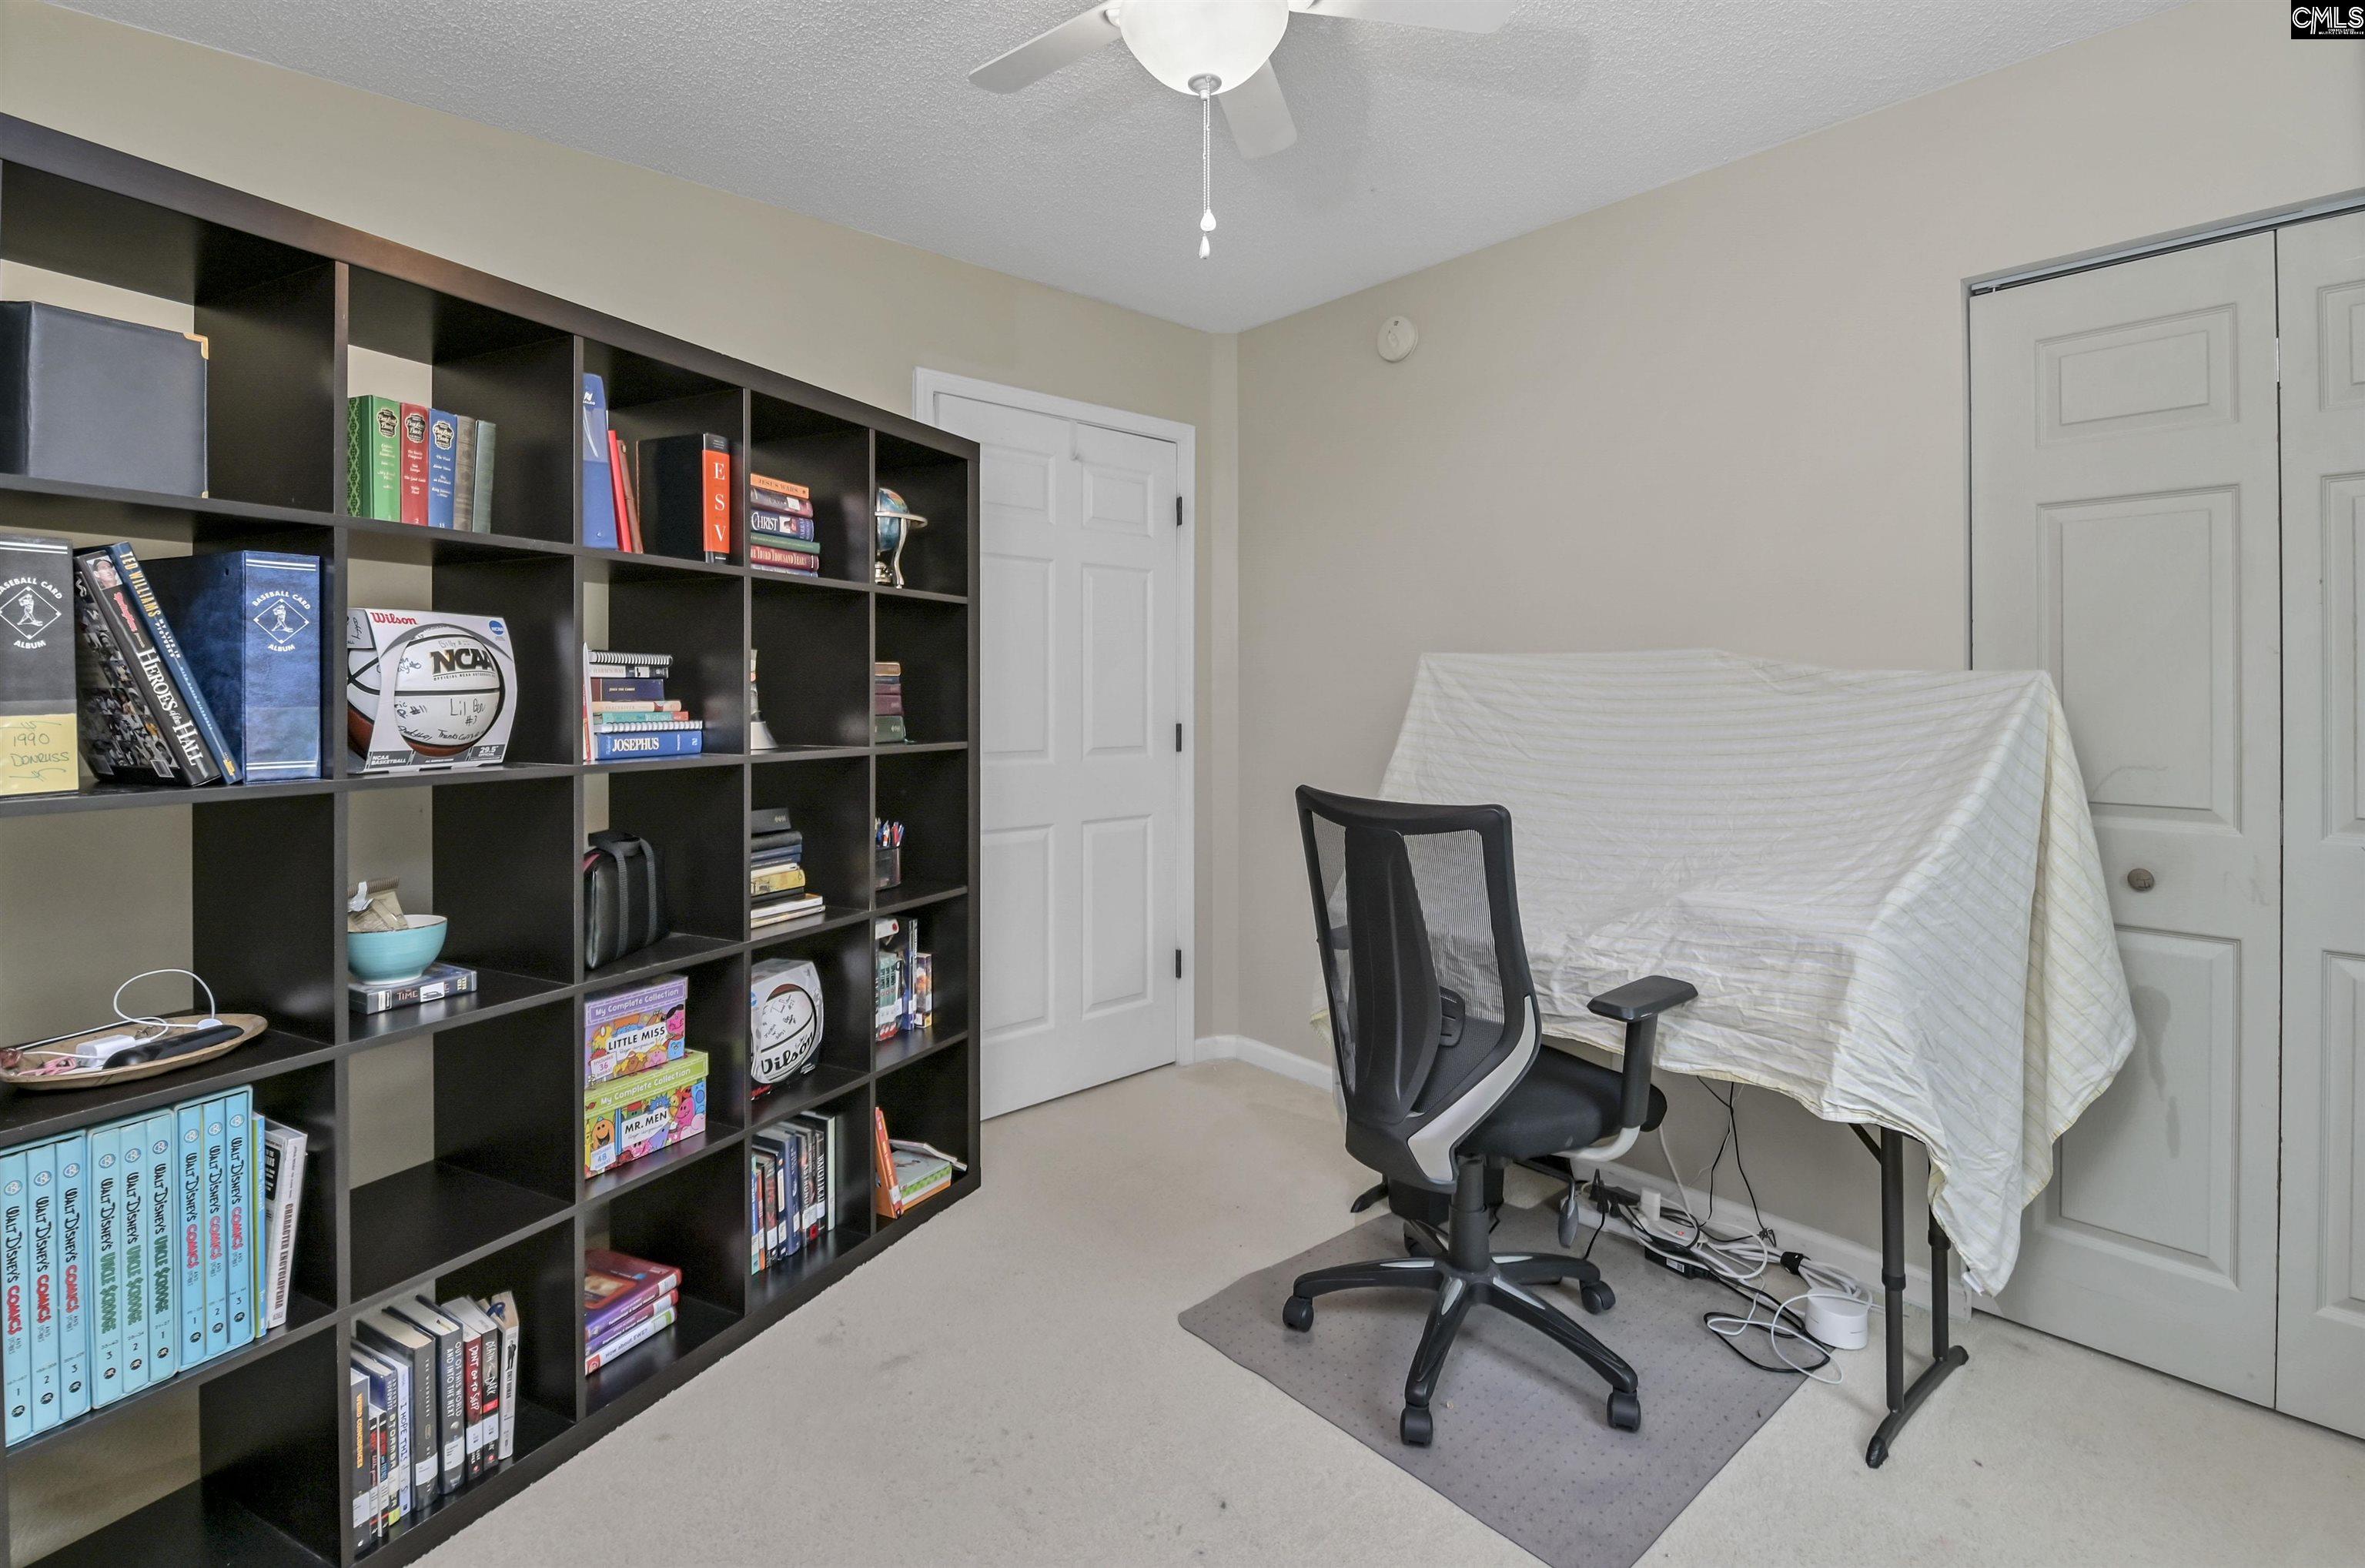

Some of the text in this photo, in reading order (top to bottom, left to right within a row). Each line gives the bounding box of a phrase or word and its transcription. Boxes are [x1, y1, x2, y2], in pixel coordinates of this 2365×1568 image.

[759, 479, 798, 493] JESUS WARS
[751, 512, 778, 531] CHRIST
[41, 580, 63, 599] CARD
[119, 550, 161, 617] TED WILLIAMS
[252, 590, 311, 610] BASEBALL CARD
[370, 612, 417, 625] Wilson
[13, 640, 46, 650] ALBUM
[155, 622, 175, 658] PICTURES
[267, 644, 296, 652] ALBUM
[430, 647, 495, 675] NCAA
[136, 647, 178, 711] HEROES
[172, 720, 203, 766] HALL
[13, 732, 50, 747] 1990
[611, 737, 660, 752] JOSEPHUS
[9, 751, 69, 767] DONRUSS
[396, 991, 418, 1001] TIME
[607, 998, 643, 1014] Complete
[644, 988, 679, 1003] Collection
[608, 1026, 665, 1051] LITTLE MISS
[599, 1061, 609, 1071] 36
[614, 1082, 653, 1100] Complete
[654, 1068, 691, 1085] Collection
[624, 1111, 667, 1135] MR. MEN
[597, 1152, 607, 1162] 48
[126, 1172, 139, 1198] WALT
[154, 1163, 166, 1189] WALT
[101, 1178, 114, 1204] WALT
[209, 1145, 222, 1260] WALT DISNEY'S COMICS
[231, 1137, 244, 1251] WALT DISNEY'S COMICS
[126, 1196, 141, 1245] DISNEY'S
[154, 1187, 169, 1235] DISNEY'S
[186, 1152, 199, 1269] WALT DISNEY'S COMICS
[101, 1202, 115, 1252] DISNEY'S
[281, 1203, 294, 1250] CHARACTER
[35, 1196, 52, 1323] WALT DISNEY'S COMICS
[65, 1188, 80, 1312] WALT DISNEY'S COMICS
[126, 1245, 142, 1279] UNCLE
[154, 1235, 169, 1268] UNCLE
[5, 1206, 22, 1335] WALT DISNEY'S COMICS
[100, 1252, 115, 1285] UNCLE
[274, 1250, 289, 1310] ENCYCLOPEDIA
[72, 1364, 78, 1372] 3
[106, 1352, 112, 1360] 3
[455, 1359, 462, 1370] OF
[44, 1376, 49, 1384] 2
[447, 1384, 455, 1399] THE
[447, 1399, 455, 1418] NEXT
